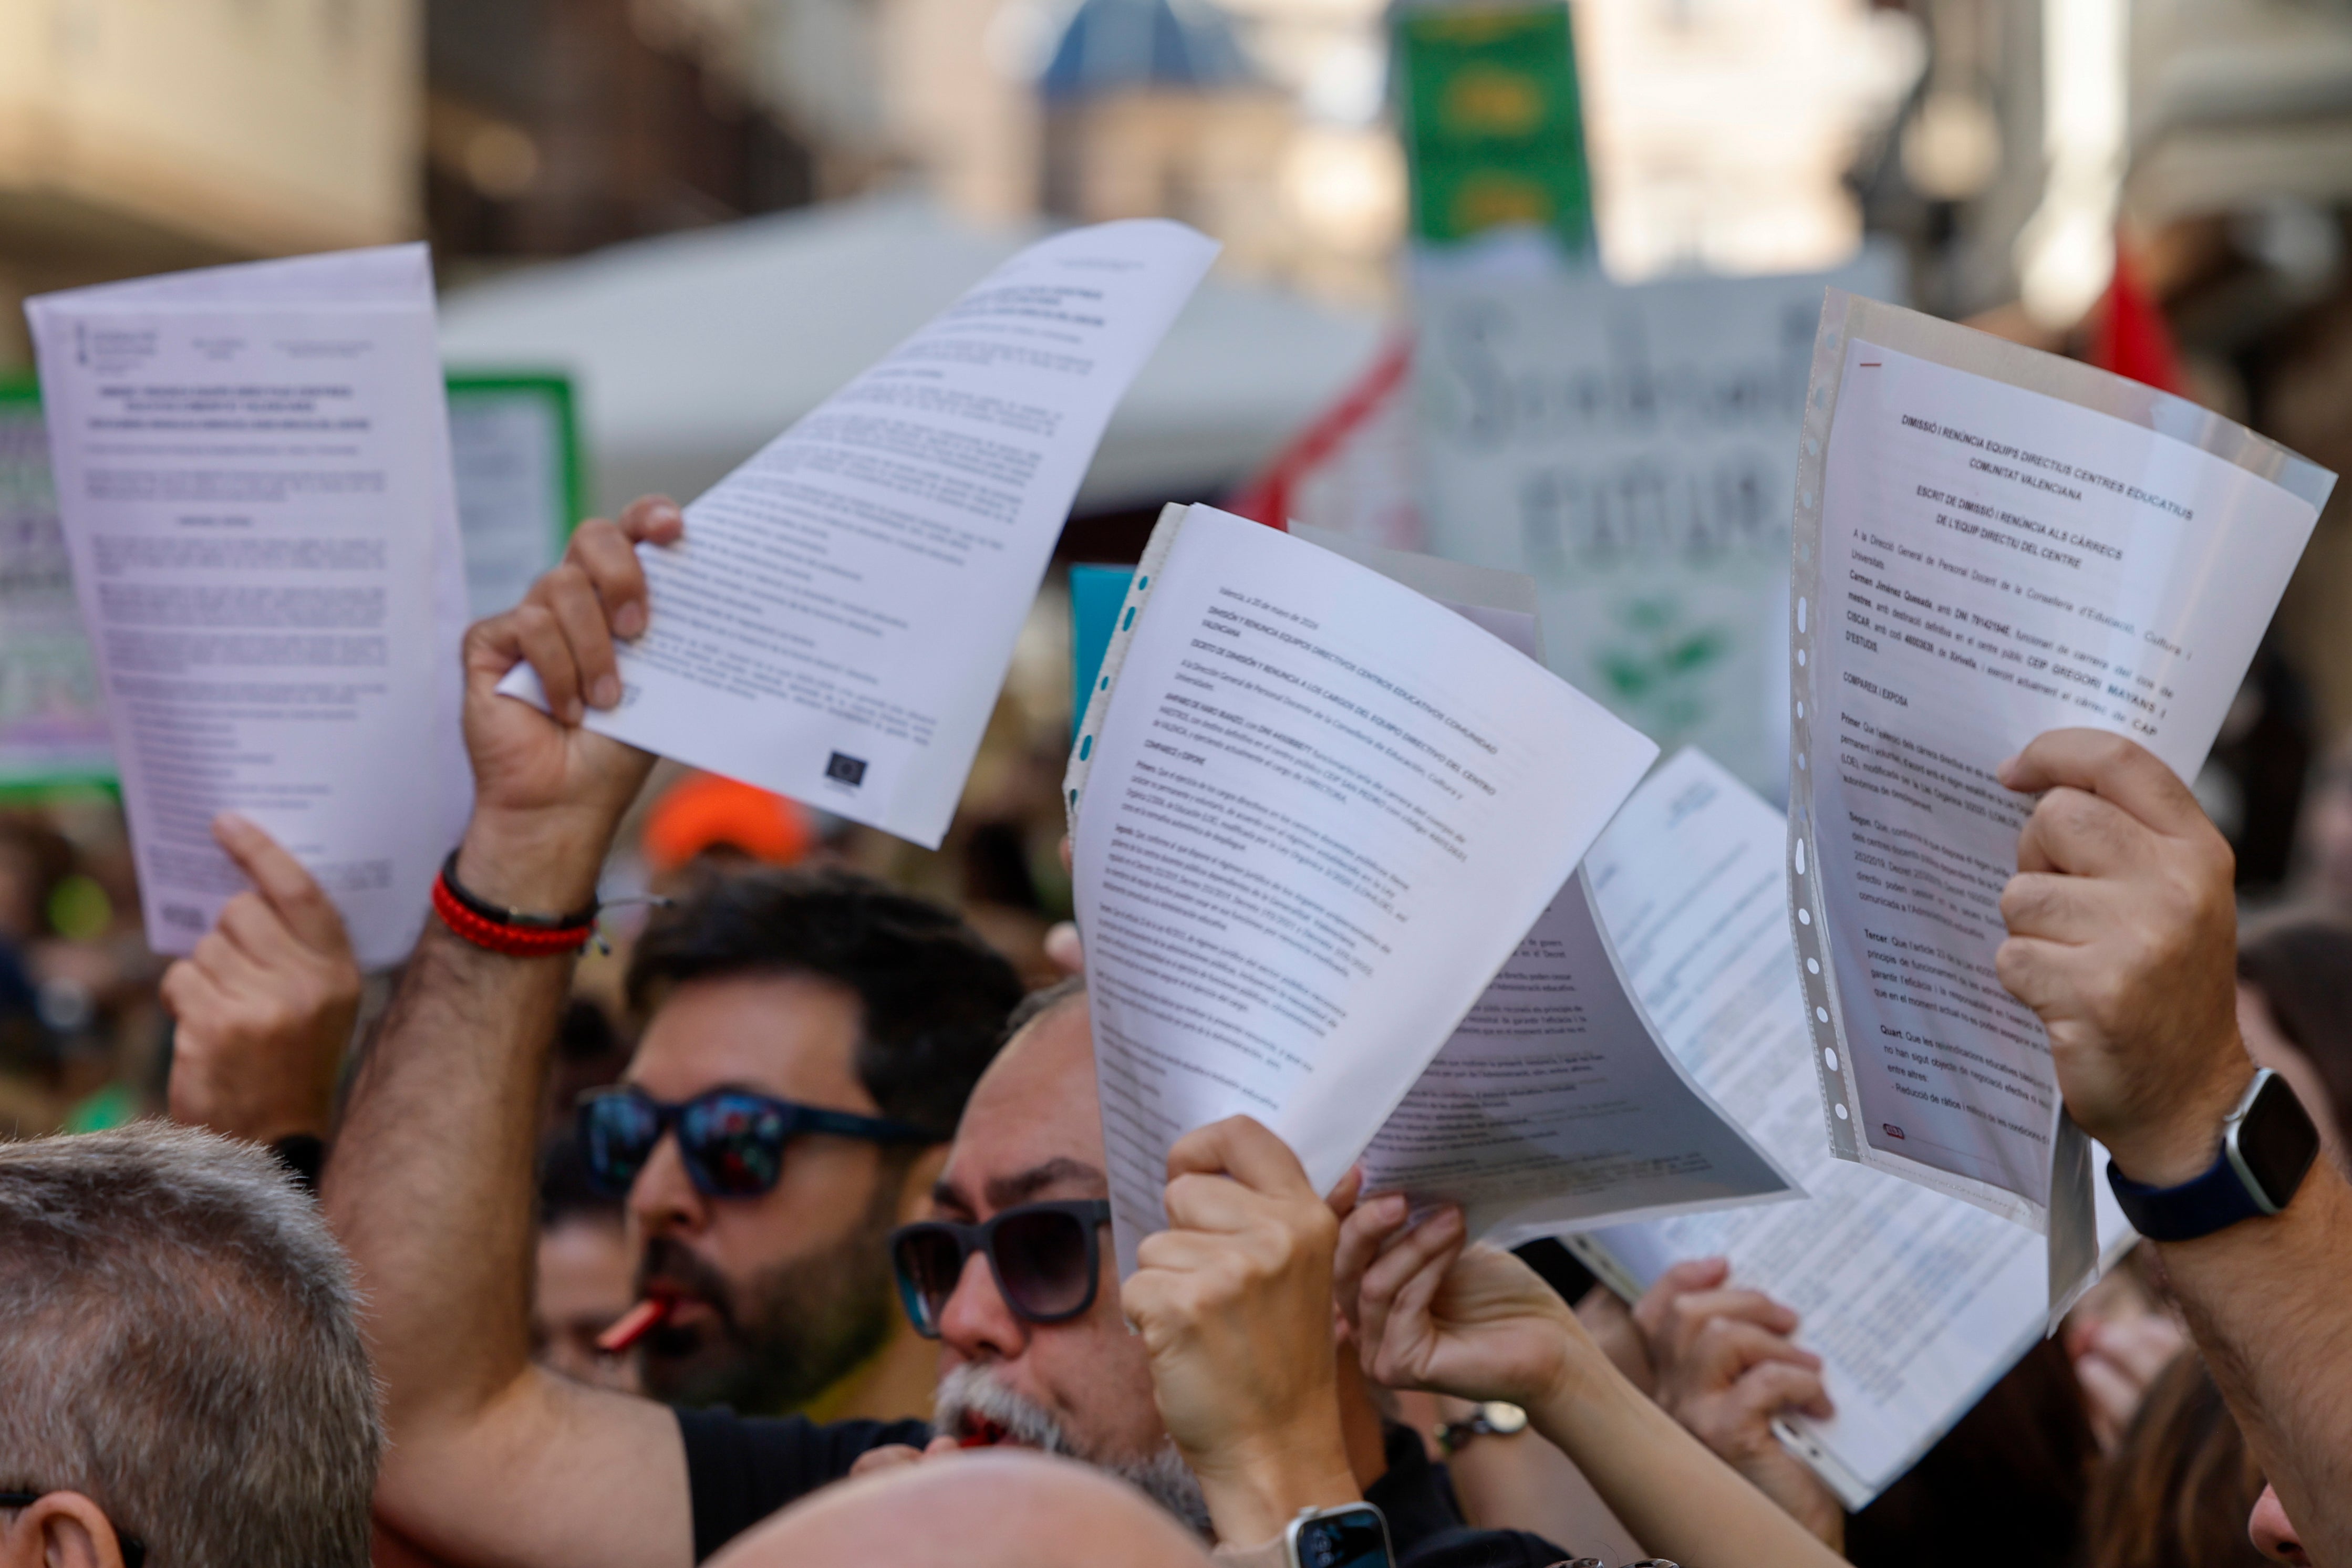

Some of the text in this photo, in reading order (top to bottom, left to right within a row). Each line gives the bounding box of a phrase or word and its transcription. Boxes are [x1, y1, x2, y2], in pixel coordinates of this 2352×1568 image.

[1902, 414, 1936, 433] DIMISSIÓ
[1943, 428, 1984, 448] RENÚNCIA
[1986, 440, 2019, 459] EQUIPS
[2021, 451, 2071, 475] DIRECTIUS
[2075, 469, 2125, 493] CENTRES
[2127, 486, 2193, 521] EDUCATIUS
[1970, 458, 2081, 500] COMUNITAT VALENCIANA
[1917, 485, 1944, 501] ESCRIT
[1946, 495, 1956, 506] DE
[1959, 499, 1993, 517] DIMISSIÓ
[2000, 512, 2046, 534] RENÚNCIA
[2048, 528, 2068, 542] ALS
[2070, 535, 2122, 560] CÀRRECS
[1936, 514, 2081, 568] DE L'EQUIP DIRECTIU DEL CENTRE
[1899, 545, 1923, 561] General
[1926, 556, 1934, 565] de
[1939, 559, 1967, 577] Personal
[1972, 569, 1997, 586] Docent
[2001, 581, 2010, 590] de
[2015, 585, 2022, 595] la
[2027, 588, 2073, 611] Conselleria
[2145, 632, 2181, 656] Cultura
[1850, 570, 1872, 586] Carmen
[1937, 605, 1951, 616] amb
[2059, 645, 2068, 654] de
[2115, 666, 2131, 677] del
[2161, 688, 2173, 699] de
[1877, 604, 1889, 614] amb
[2028, 657, 2048, 669] CEIP
[2053, 664, 2101, 688] GREGORI
[2108, 685, 2154, 713] MAYANS
[1279, 632, 1311, 650] EQUIPOS
[1311, 644, 1356, 671] DIRECTIVOS
[1357, 669, 1394, 692] CENTROS
[1393, 687, 1444, 720] EDUCATIVOS
[1444, 715, 1497, 754] COMUNIDAD
[1874, 624, 1887, 635] amb
[1939, 649, 1946, 657] de
[2113, 712, 2126, 722] de
[2133, 720, 2157, 735] CAP
[1882, 689, 1908, 706] EXPOSA
[1307, 684, 1322, 694] LOS
[1323, 691, 1354, 710] CARGOS
[1354, 705, 1369, 718] DEL
[1371, 715, 1403, 738] EQUIPO
[1403, 733, 1446, 761] DIRECTIVO
[1445, 757, 1460, 772] DEL
[1463, 771, 1496, 795] CENTRO
[1891, 937, 1907, 949] Que
[1900, 958, 1909, 967] de
[1874, 989, 1887, 998] que
[1908, 998, 1937, 1011] moment
[1884, 1046, 1929, 1064] no han sigut
[1906, 1032, 1933, 1047] Que les
[1888, 1065, 1905, 1076] entre
[1895, 1083, 1928, 1100] Reducció
[1930, 1094, 1939, 1104] de
